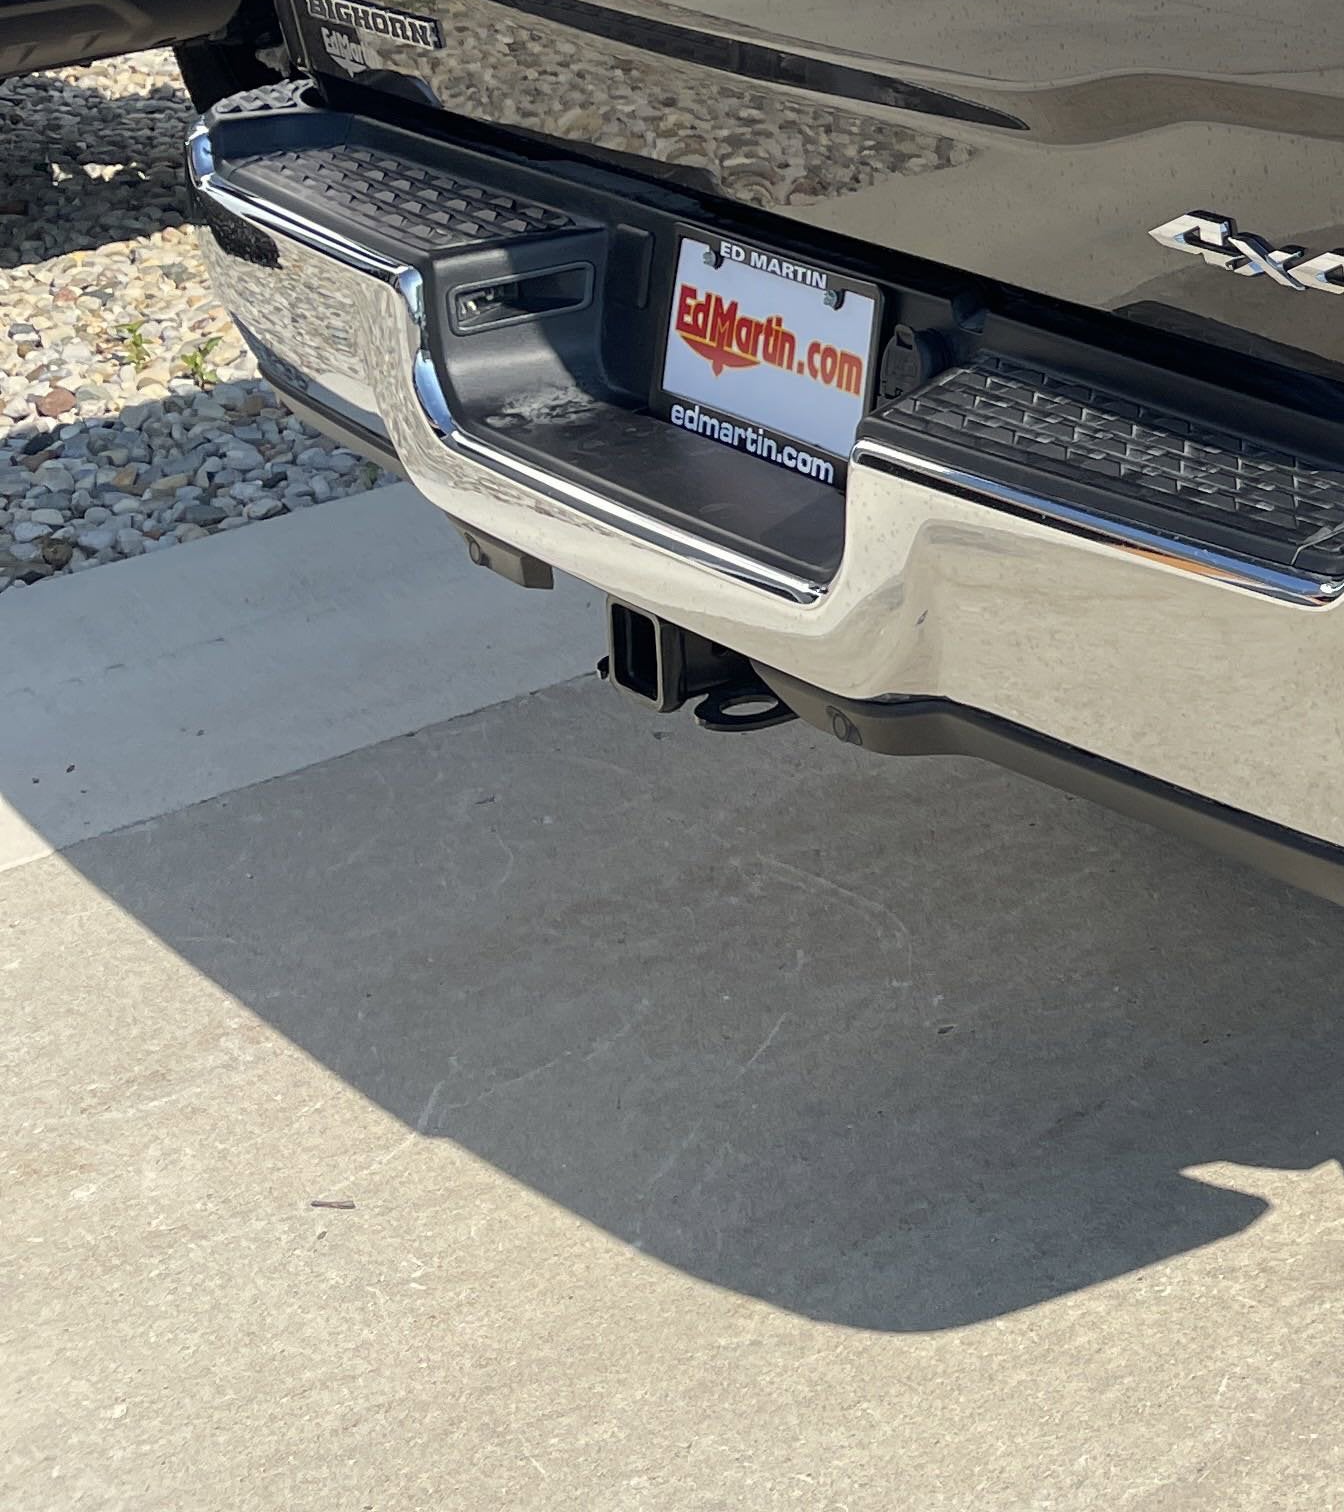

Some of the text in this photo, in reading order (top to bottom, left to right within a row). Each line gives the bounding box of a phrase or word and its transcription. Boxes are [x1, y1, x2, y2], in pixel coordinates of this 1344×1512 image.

[719, 242, 828, 289] ED MARTIN
[675, 284, 864, 396] EdMartin.com
[670, 403, 835, 484] edmartin.com
